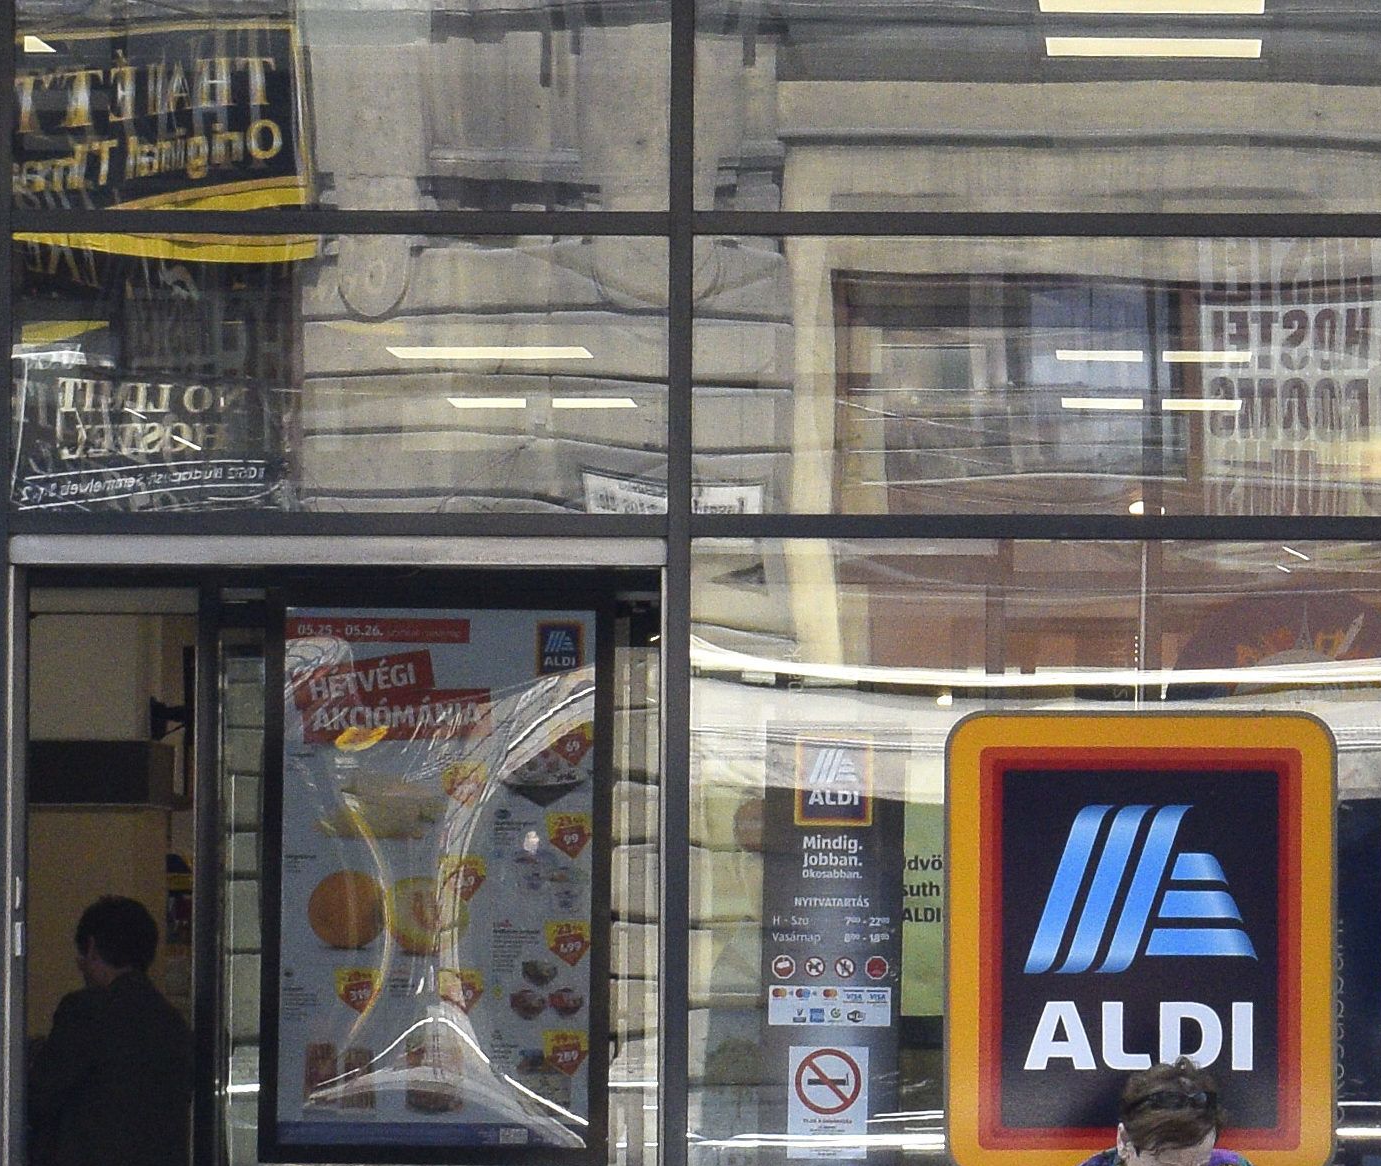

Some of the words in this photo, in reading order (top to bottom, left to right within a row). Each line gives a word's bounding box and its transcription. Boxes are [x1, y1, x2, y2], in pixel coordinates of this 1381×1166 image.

[543, 656, 577, 668] ALDI
[306, 661, 417, 702] HÉTVÉGI
[807, 789, 860, 807] ALDI
[802, 834, 863, 854] Mindig.
[802, 852, 863, 868] Jobban.
[904, 854, 943, 872] dvö
[794, 894, 870, 909] NYITVATARTÁS
[772, 932, 821, 945] Vasárnap
[1024, 1000, 1254, 1071] ALDI
